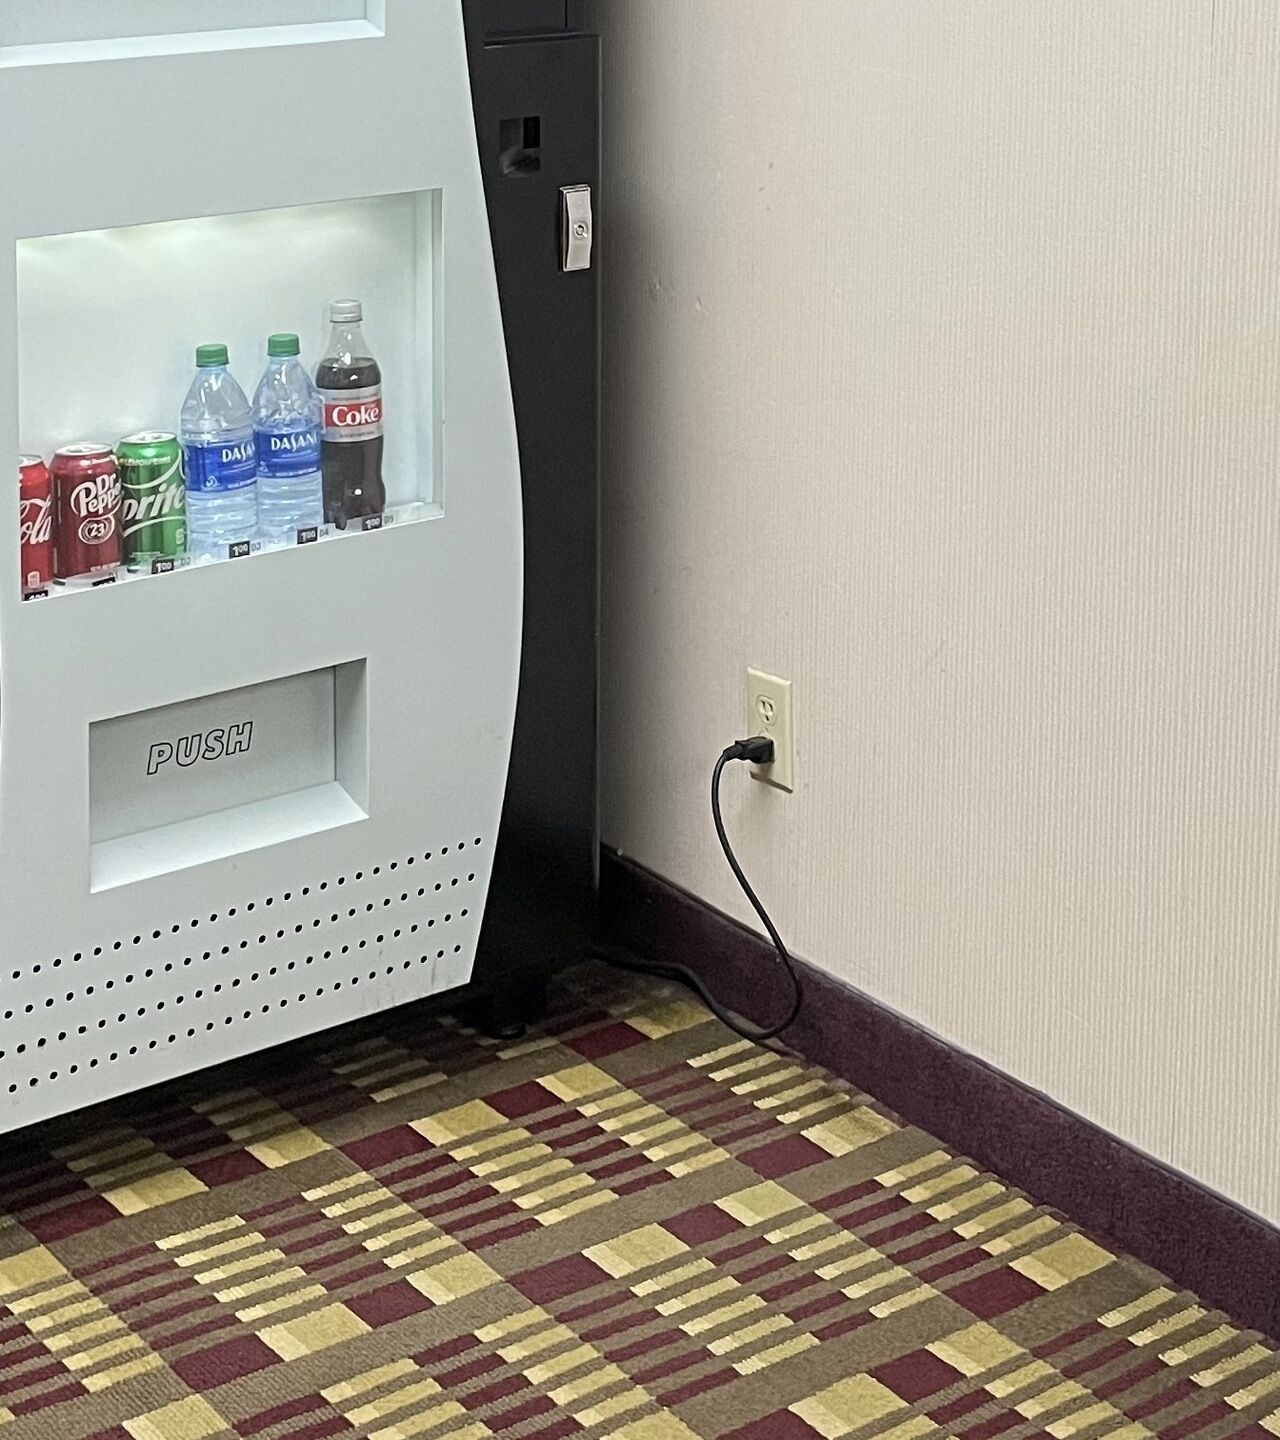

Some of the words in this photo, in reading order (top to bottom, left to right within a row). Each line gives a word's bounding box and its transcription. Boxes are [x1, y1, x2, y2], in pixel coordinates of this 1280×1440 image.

[332, 404, 380, 427] Coke
[270, 432, 318, 453] DASANI
[96, 473, 117, 496] Dr
[71, 481, 122, 517] Peppe
[89, 523, 105, 537] 23
[147, 720, 254, 775] PUSH
